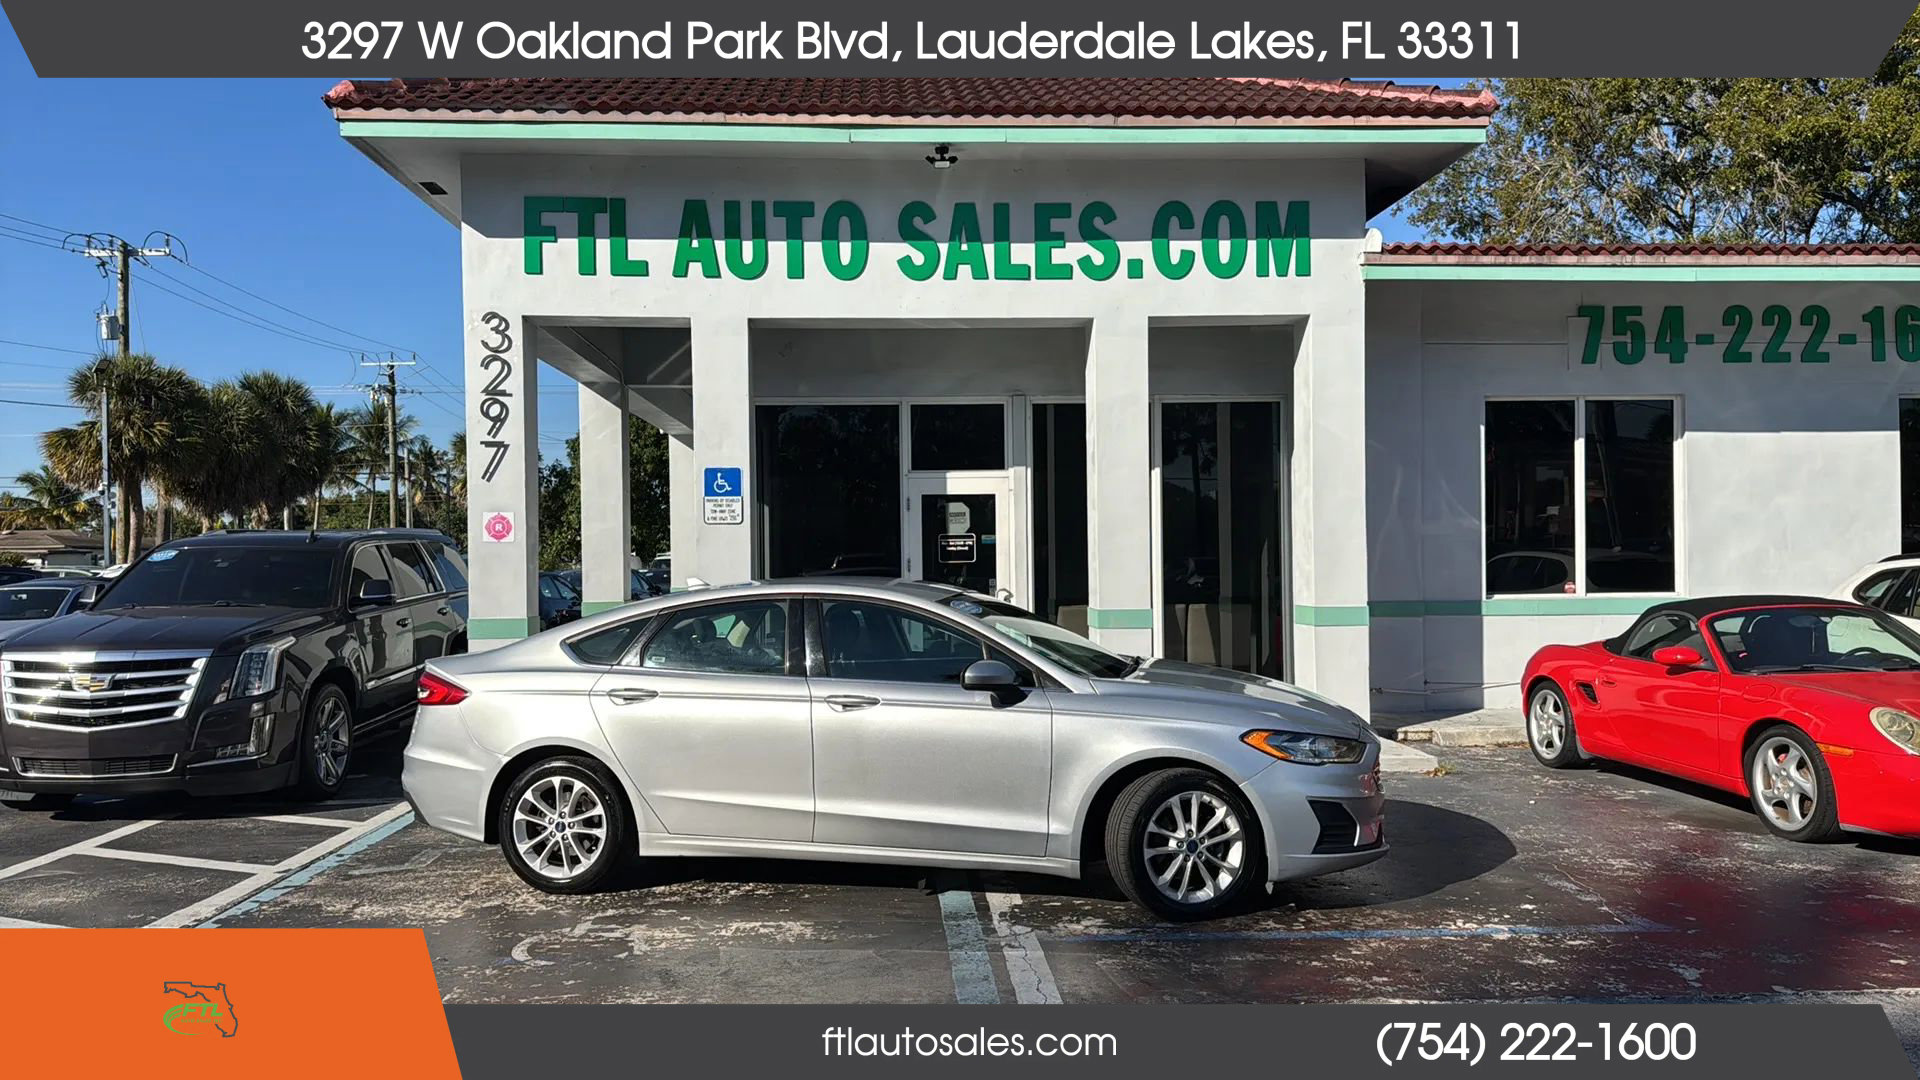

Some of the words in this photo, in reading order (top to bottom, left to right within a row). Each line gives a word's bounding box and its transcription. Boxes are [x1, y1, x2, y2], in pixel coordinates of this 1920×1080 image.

[522, 195, 650, 278] FTL
[672, 199, 870, 281] AUTO
[896, 199, 1313, 282] SALES.COM
[479, 311, 513, 483] 3297
[495, 523, 504, 532] R
